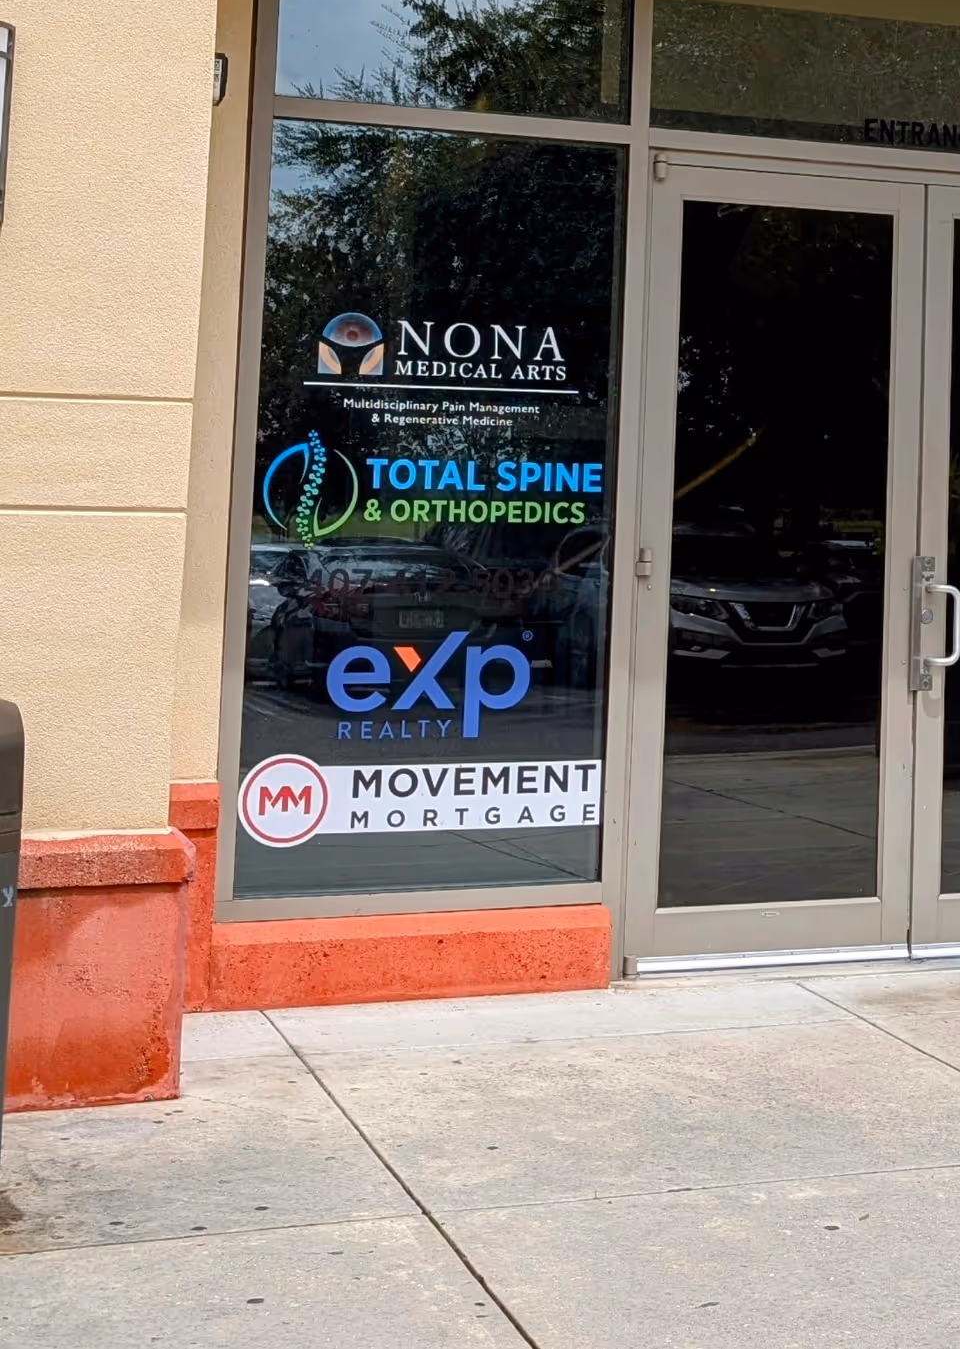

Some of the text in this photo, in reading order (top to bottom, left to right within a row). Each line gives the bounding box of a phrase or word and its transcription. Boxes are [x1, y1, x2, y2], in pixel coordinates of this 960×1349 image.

[397, 320, 565, 362] NONA
[395, 361, 567, 381] MEDICAL ARTS
[343, 398, 540, 415] Multidisciplinary Pain Management
[372, 413, 513, 427] & Regenerative Medicine
[366, 459, 603, 493] TOTAL SPINE
[364, 499, 585, 524] & ORTHOPEDICS
[337, 720, 452, 740] REALTY
[352, 764, 597, 798] MOVEMENT
[351, 803, 596, 829] MORTGAGE
